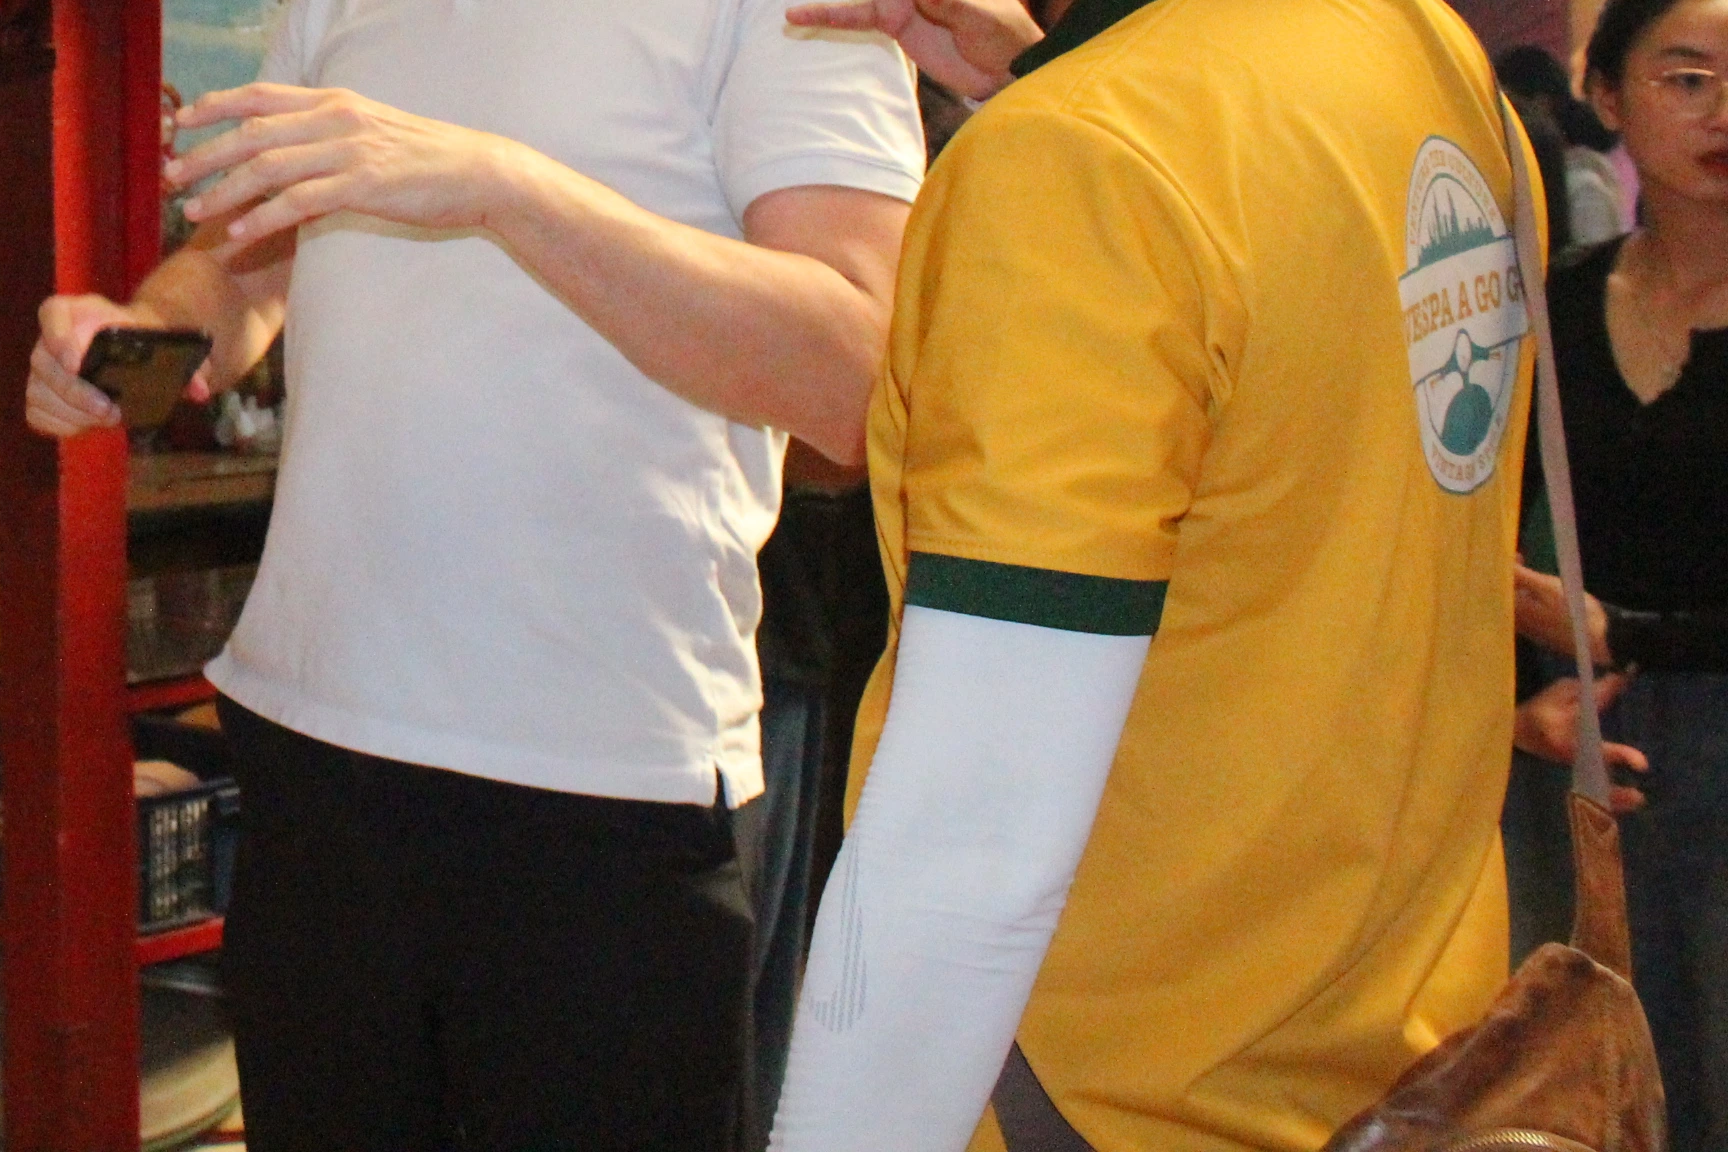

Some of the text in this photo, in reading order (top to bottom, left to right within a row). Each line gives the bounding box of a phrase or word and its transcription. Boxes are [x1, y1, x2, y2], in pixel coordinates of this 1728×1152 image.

[1457, 281, 1473, 320] A
[1474, 270, 1501, 313] GO
[1505, 265, 1526, 302] G
